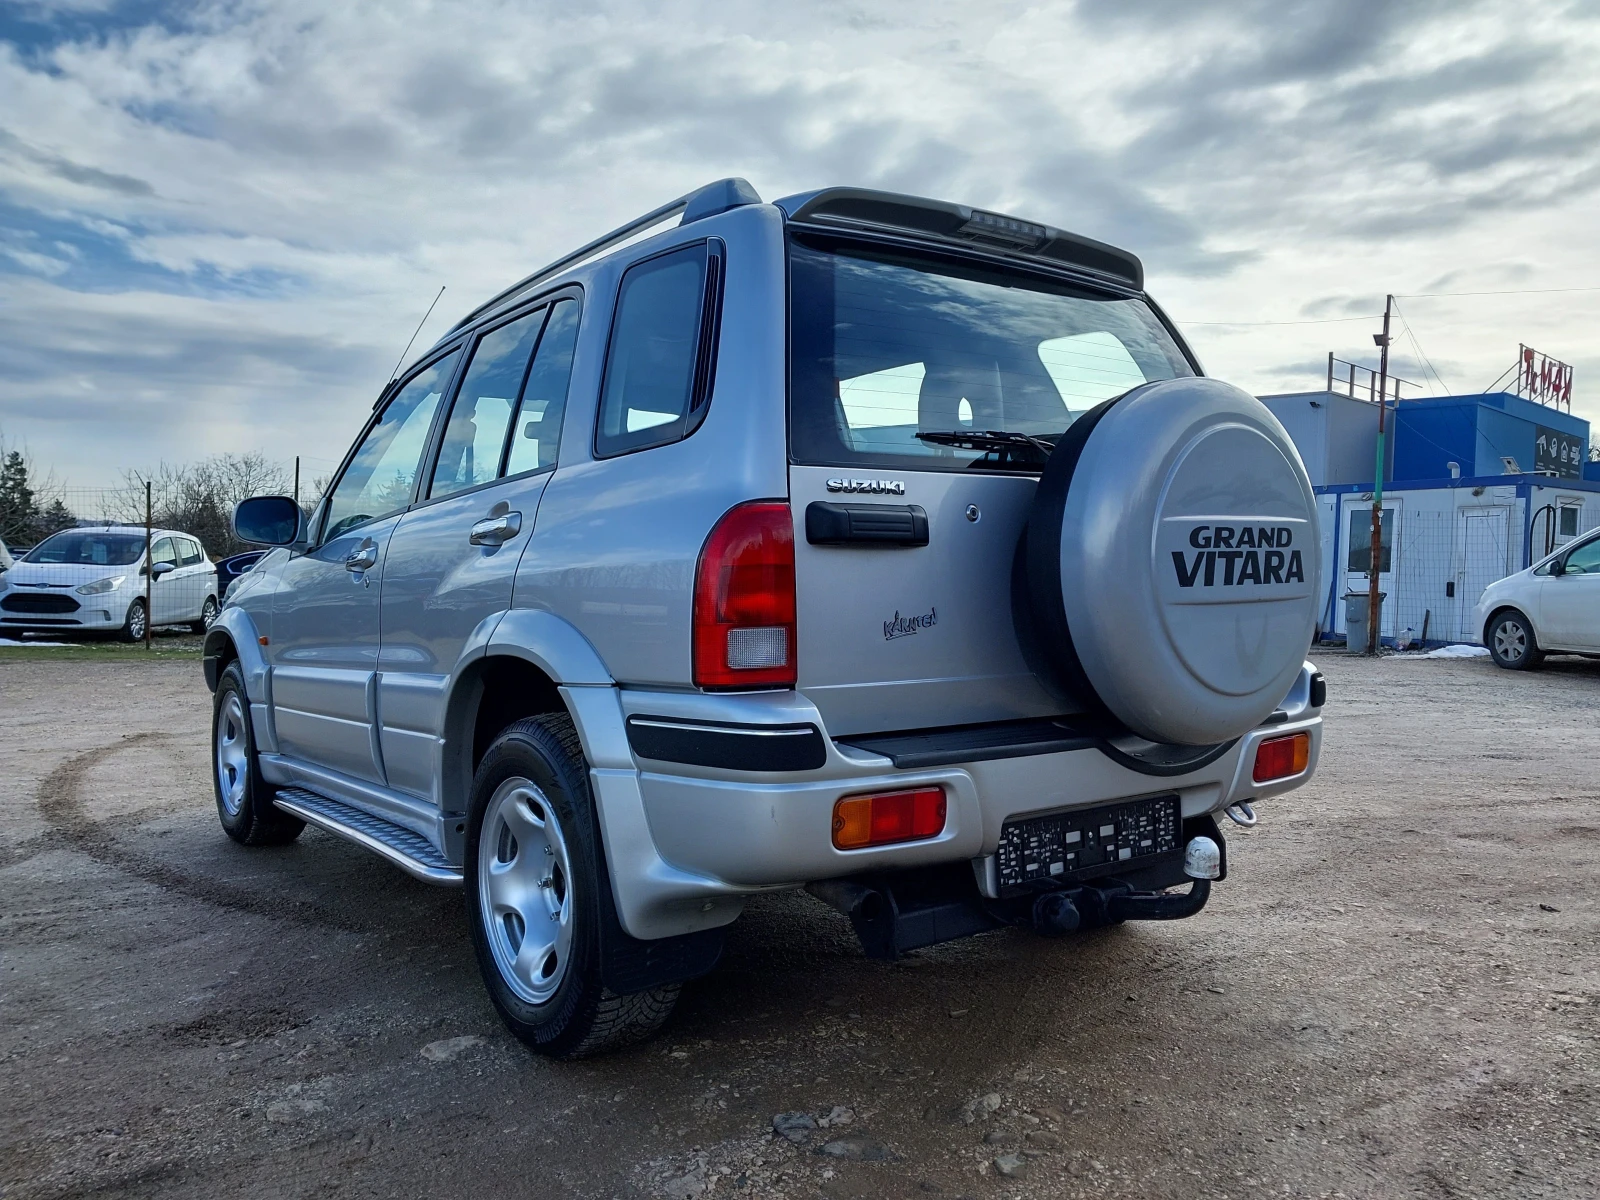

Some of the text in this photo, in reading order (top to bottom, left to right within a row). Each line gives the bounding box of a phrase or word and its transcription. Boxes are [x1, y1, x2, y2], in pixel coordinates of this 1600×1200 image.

[826, 478, 905, 496] SUZUKI
[1189, 526, 1293, 549] GRAND
[1171, 550, 1305, 588] VITARA
